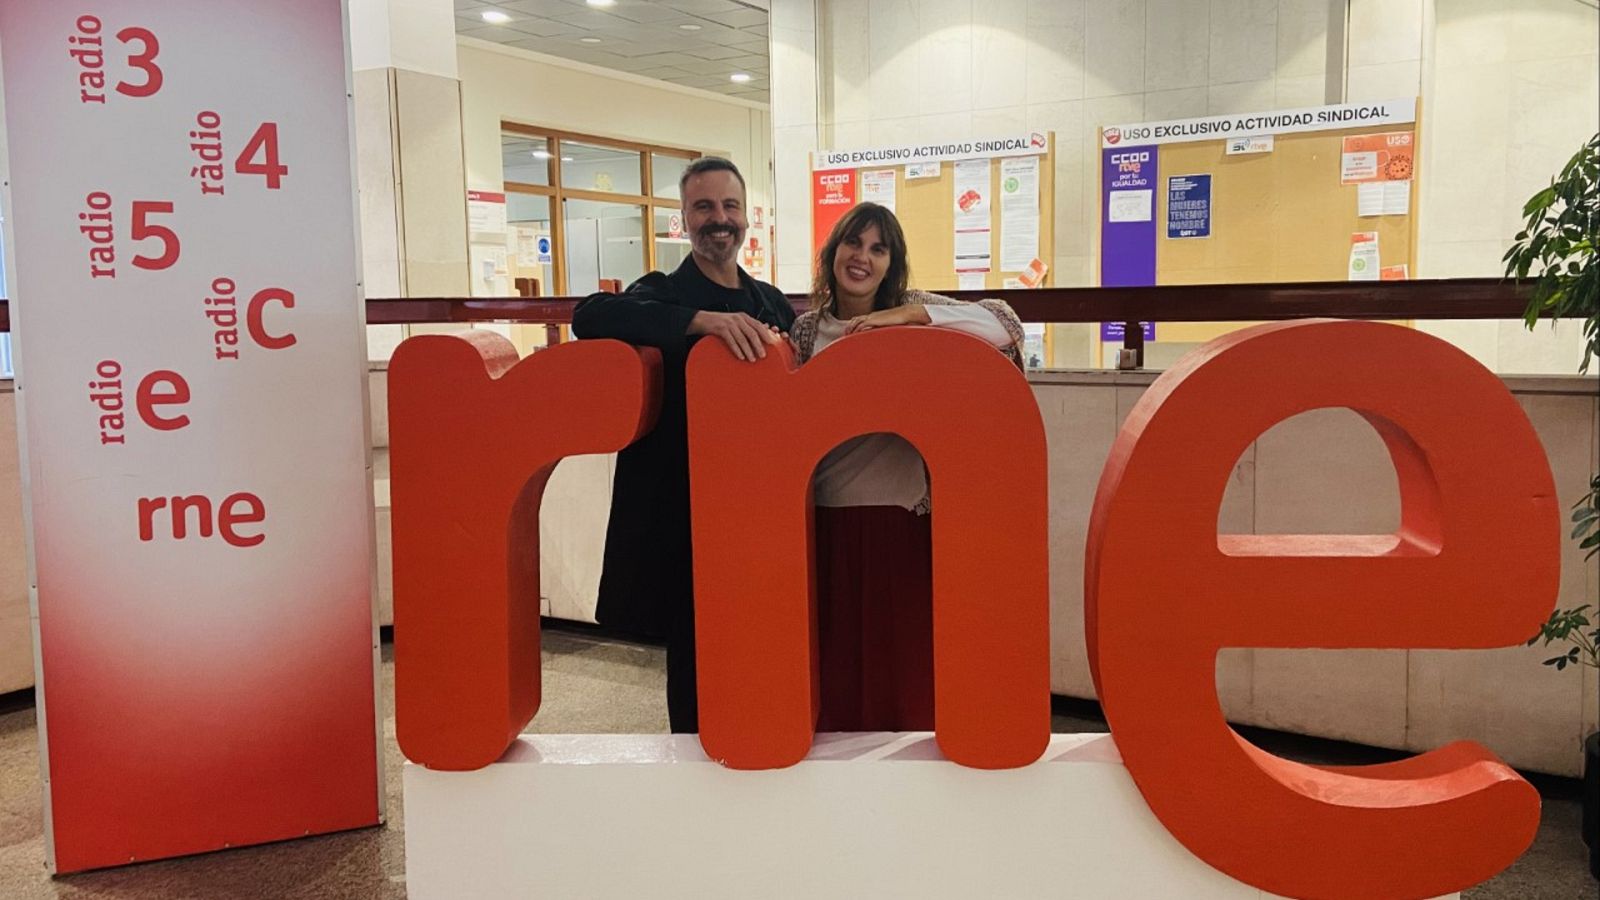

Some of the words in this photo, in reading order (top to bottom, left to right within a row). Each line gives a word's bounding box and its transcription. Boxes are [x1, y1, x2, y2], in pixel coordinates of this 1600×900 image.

[68, 15, 105, 103] radio
[115, 27, 163, 97] 3
[1123, 127, 1151, 140] USO
[1154, 120, 1231, 138] EXCLUSIVO
[1235, 113, 1313, 131] ACTIVIDAD
[1317, 106, 1389, 123] SINDICAL
[190, 110, 224, 195] ràdio
[235, 122, 288, 190] 4
[828, 153, 850, 164] USO
[852, 149, 911, 162] EXCLUSIVO
[913, 143, 972, 157] ACTIVIDAD
[974, 138, 1029, 152] SINDICAL
[1111, 152, 1150, 164] CCOO
[820, 174, 850, 185] CCOO
[1112, 178, 1147, 188] IGUALDAD
[1170, 191, 1186, 201] LAS
[79, 192, 115, 278] radio
[131, 201, 180, 270] 5
[204, 277, 238, 360] radio
[247, 288, 297, 349] c
[89, 360, 125, 445] radio
[136, 370, 190, 431] e
[138, 492, 265, 547] rne
[388, 318, 1560, 900] rne
